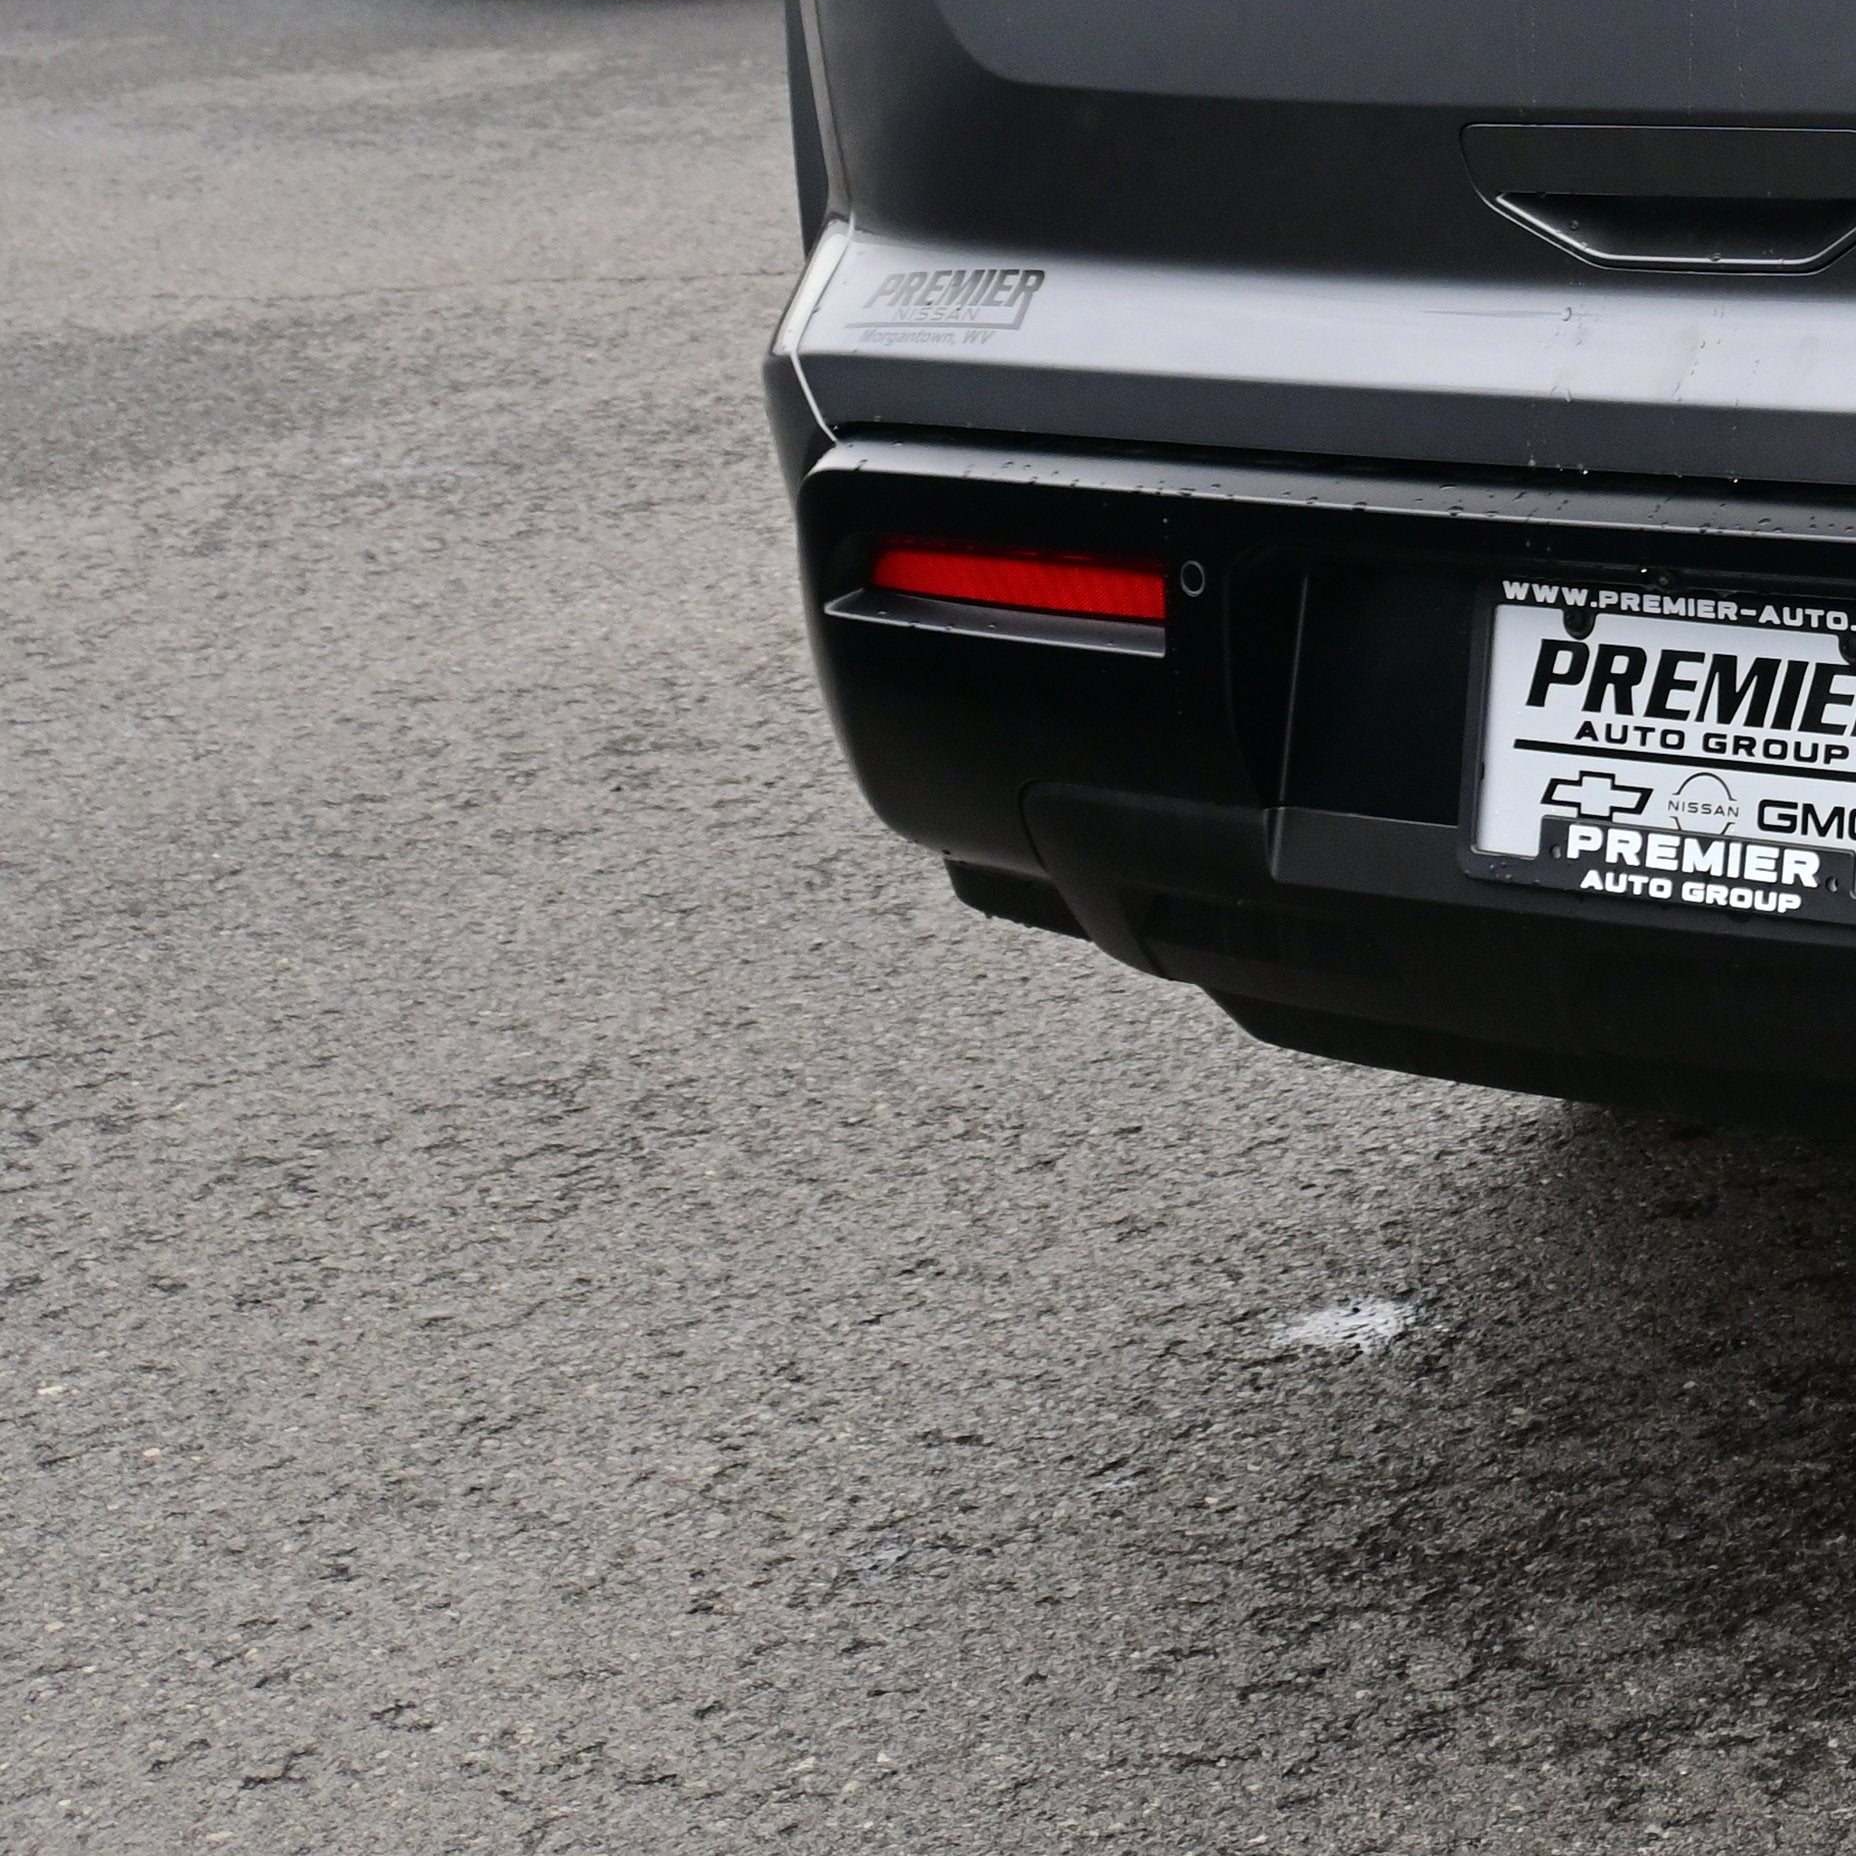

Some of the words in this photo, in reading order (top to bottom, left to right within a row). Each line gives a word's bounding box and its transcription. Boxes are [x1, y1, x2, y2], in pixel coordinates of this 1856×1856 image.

[862, 269, 1046, 309] PREMIER
[893, 308, 979, 322] NISSAN
[961, 329, 995, 344] WV
[1574, 721, 1686, 751] AUTO
[1702, 733, 1851, 765] GROUP
[1667, 798, 1740, 819] NISSAN
[1566, 824, 1821, 888] PREMIER
[1580, 870, 1673, 900] AUTO
[1680, 881, 1803, 914] GROUP
